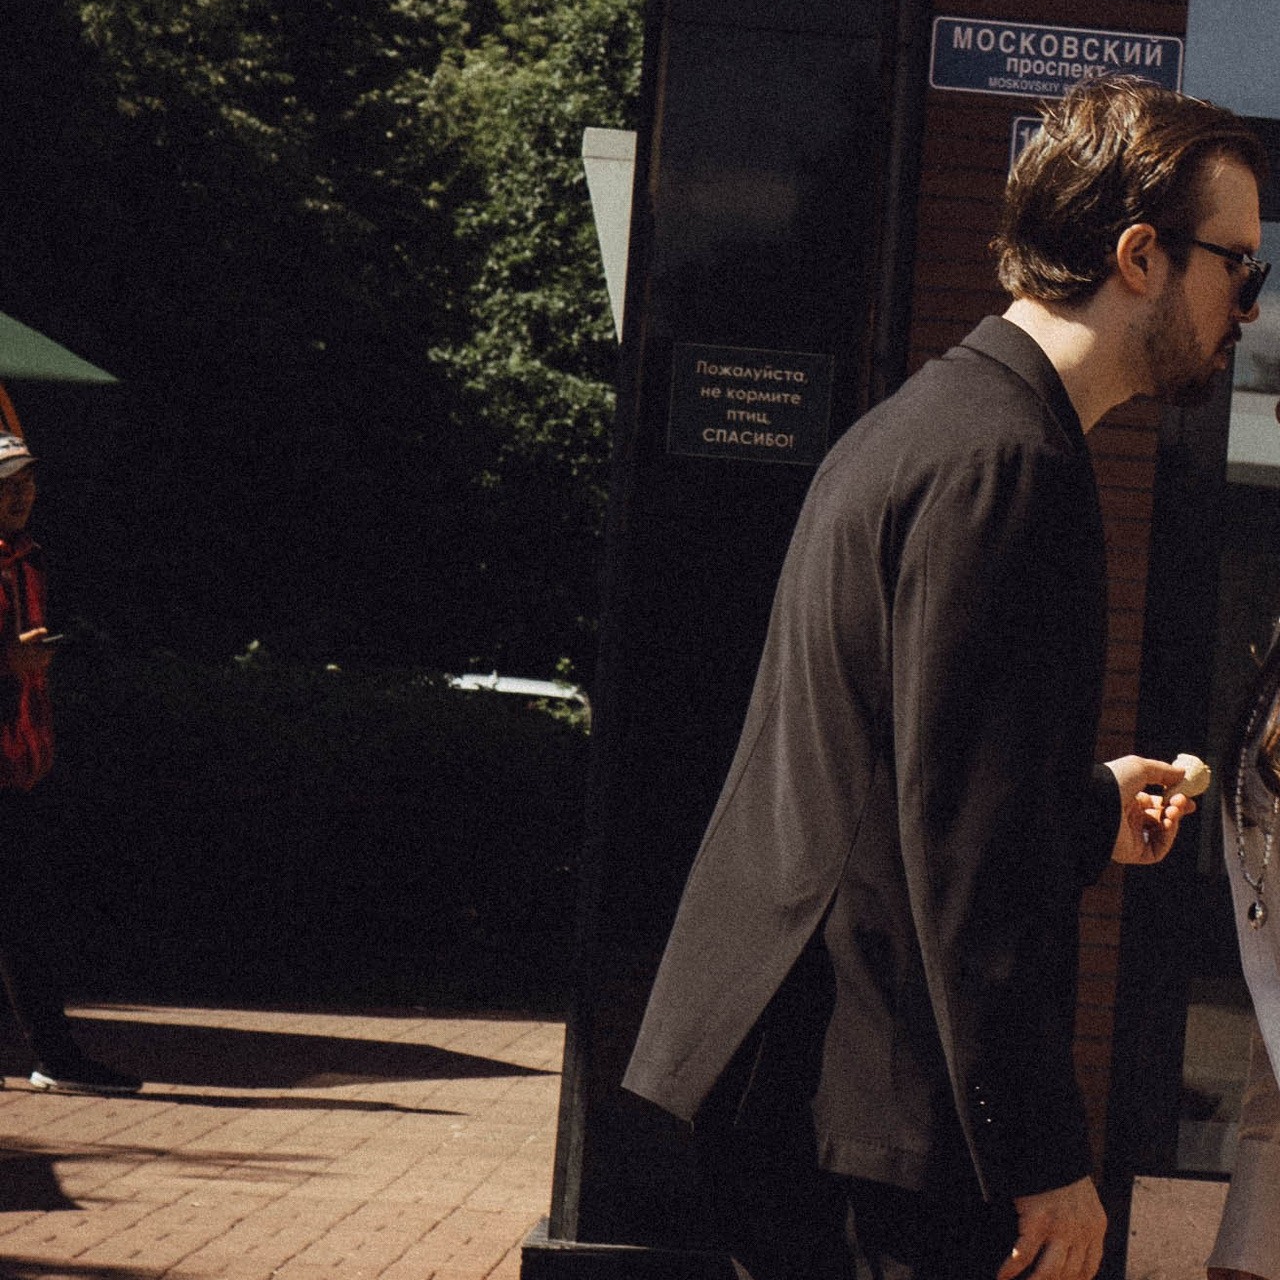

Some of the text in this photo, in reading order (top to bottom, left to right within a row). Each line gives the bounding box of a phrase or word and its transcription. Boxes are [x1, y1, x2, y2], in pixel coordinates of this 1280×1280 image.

[953, 25, 1164, 67] МОСКОВСКИЙ
[1006, 57, 1107, 78] проспект
[696, 360, 809, 384] Пожалуйста,
[701, 386, 801, 405] не кормите
[702, 428, 794, 447] СПАСИБО!
